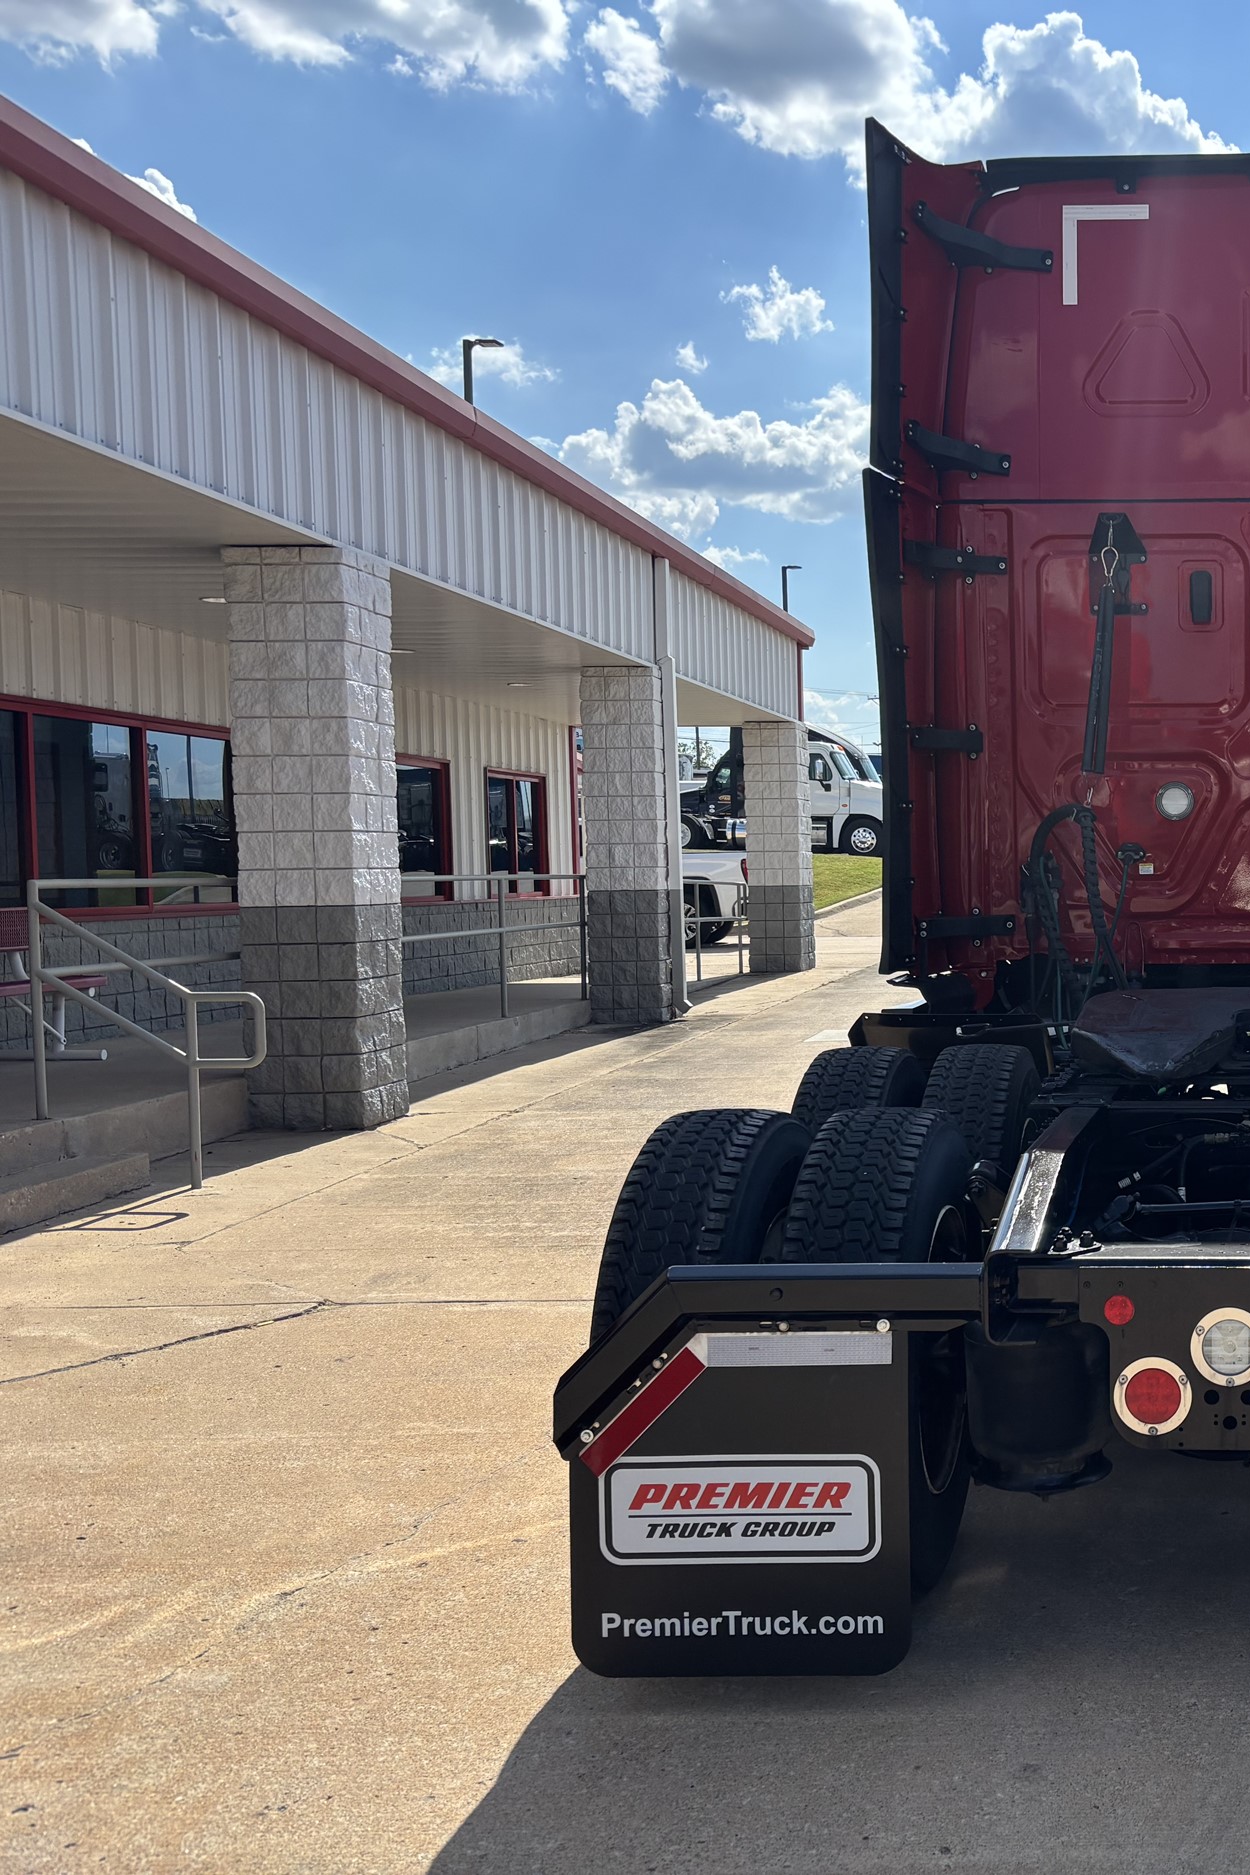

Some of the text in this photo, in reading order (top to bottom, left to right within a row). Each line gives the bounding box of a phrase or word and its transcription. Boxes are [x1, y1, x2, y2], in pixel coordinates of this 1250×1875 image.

[628, 1481, 852, 1511] PREMIER
[646, 1521, 836, 1539] TRUCK GROUP
[601, 1610, 884, 1638] PremierTruck.com
